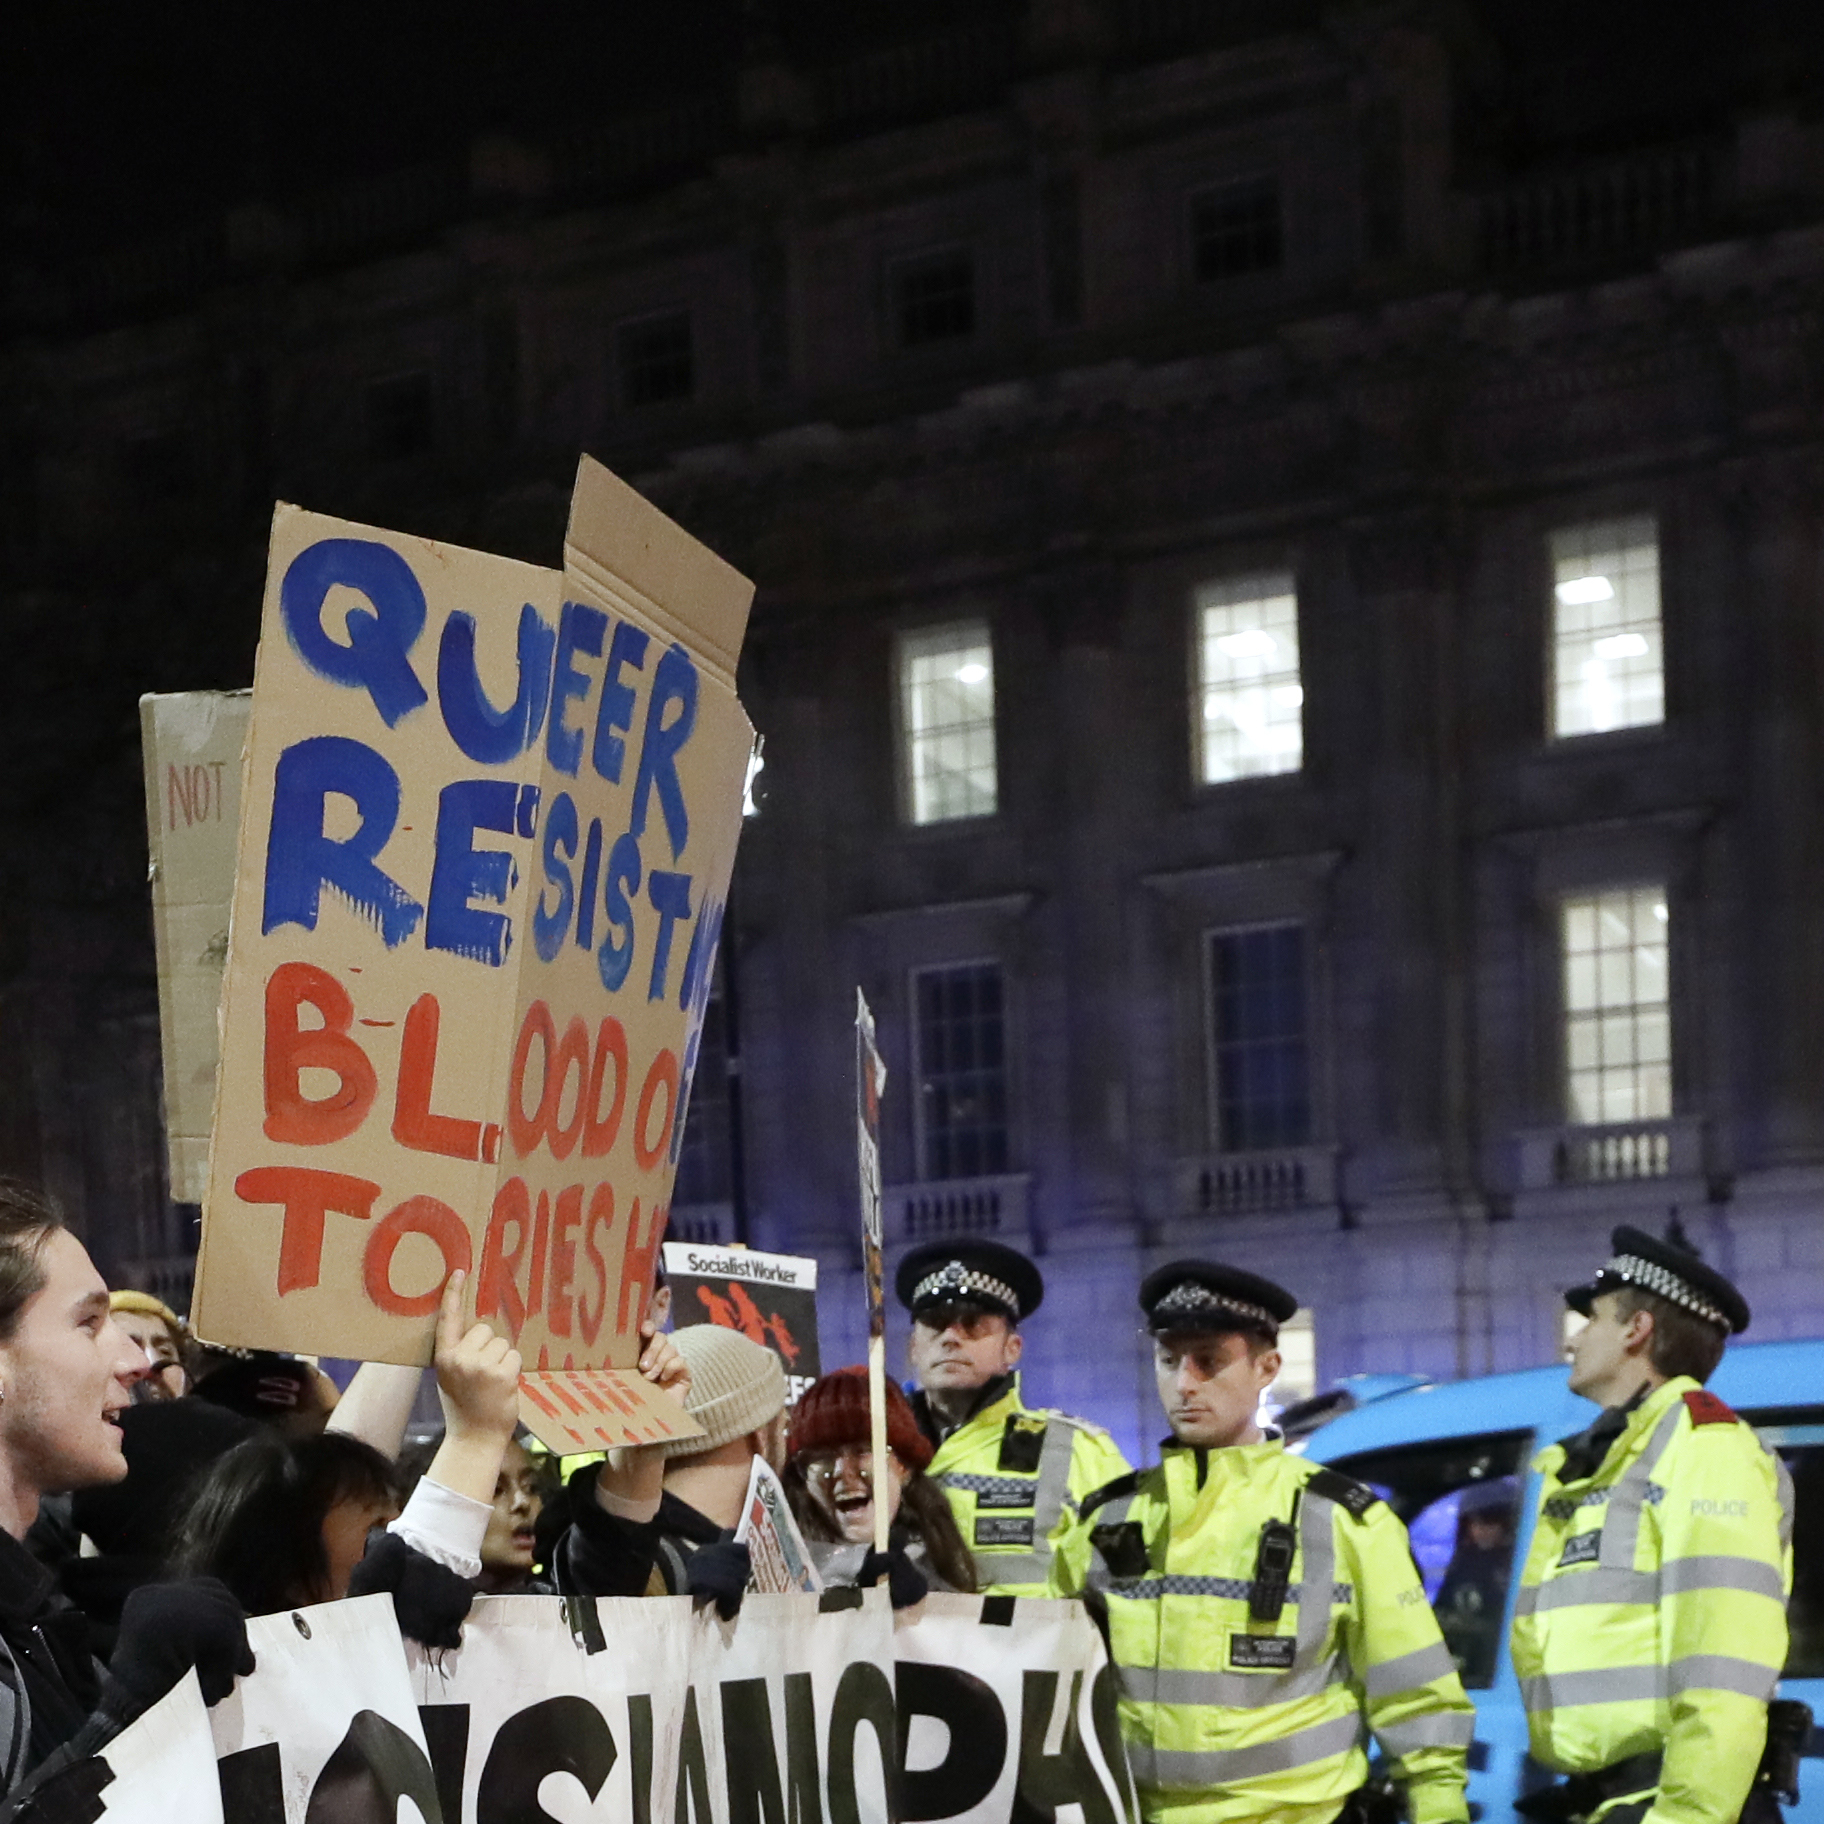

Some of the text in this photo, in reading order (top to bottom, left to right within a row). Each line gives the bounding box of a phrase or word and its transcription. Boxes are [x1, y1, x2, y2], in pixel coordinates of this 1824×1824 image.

[279, 537, 702, 869] QUEER
[168, 761, 226, 831] NOT
[263, 962, 628, 1163] BLOOD
[234, 1165, 612, 1348] TORIES
[688, 1252, 797, 1284] Socialist Worker
[1690, 1500, 1748, 1516] POLICE
